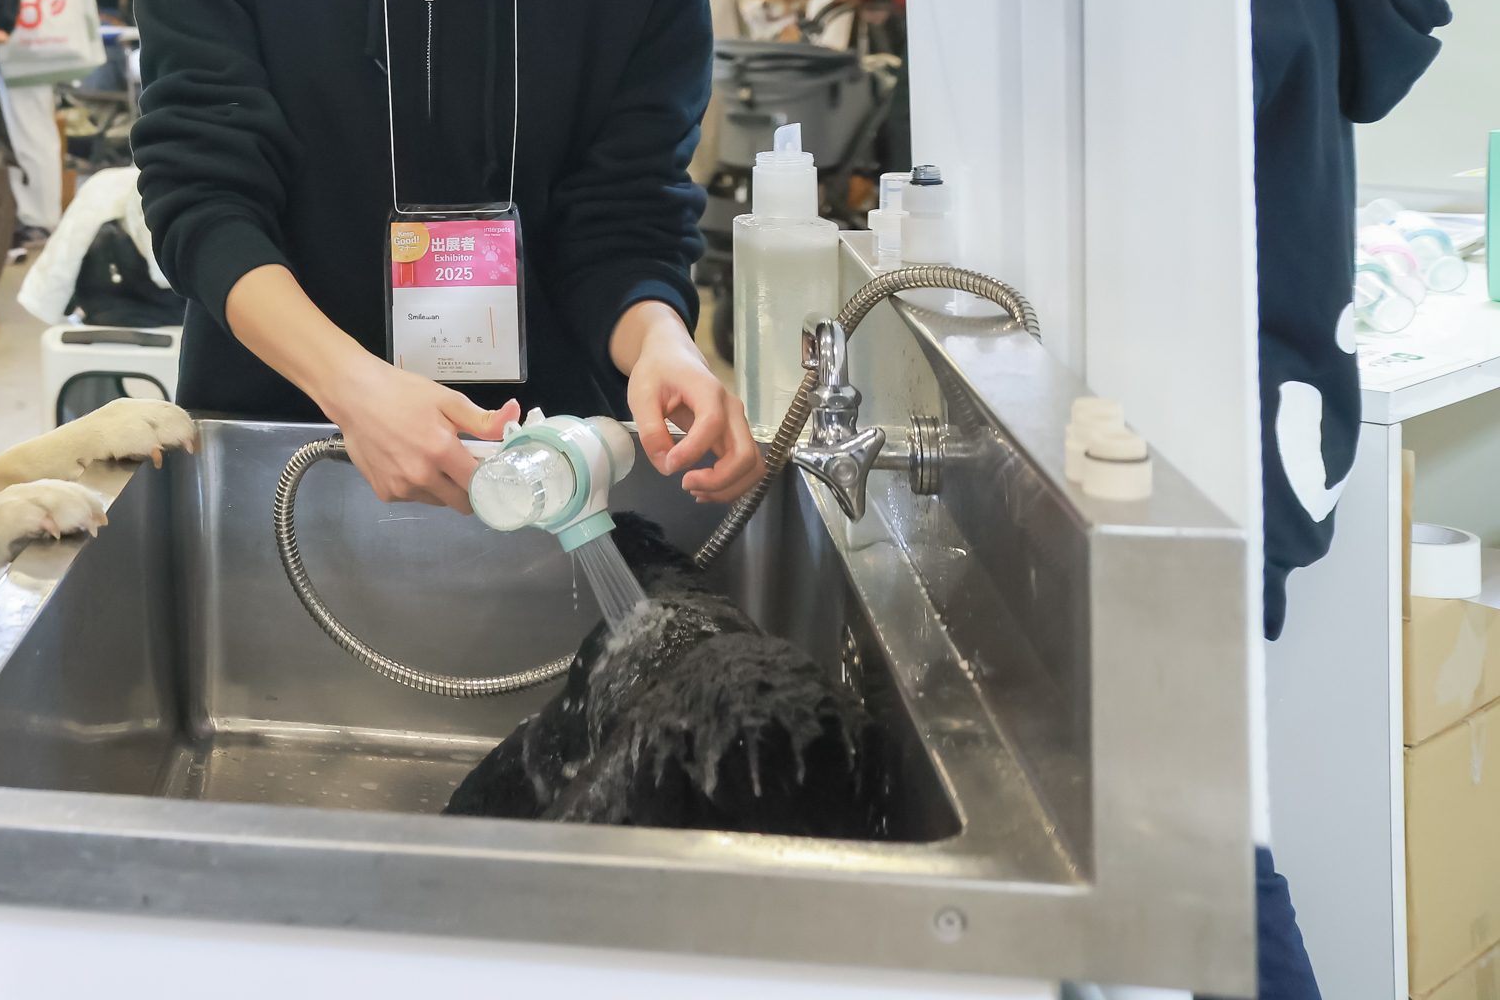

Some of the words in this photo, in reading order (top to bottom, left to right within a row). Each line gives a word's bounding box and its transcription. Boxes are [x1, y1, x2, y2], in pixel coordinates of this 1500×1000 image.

[393, 236, 420, 246] Good!
[431, 236, 475, 252] 出展者
[434, 254, 473, 262] Exhibitor
[435, 267, 474, 281] 2025
